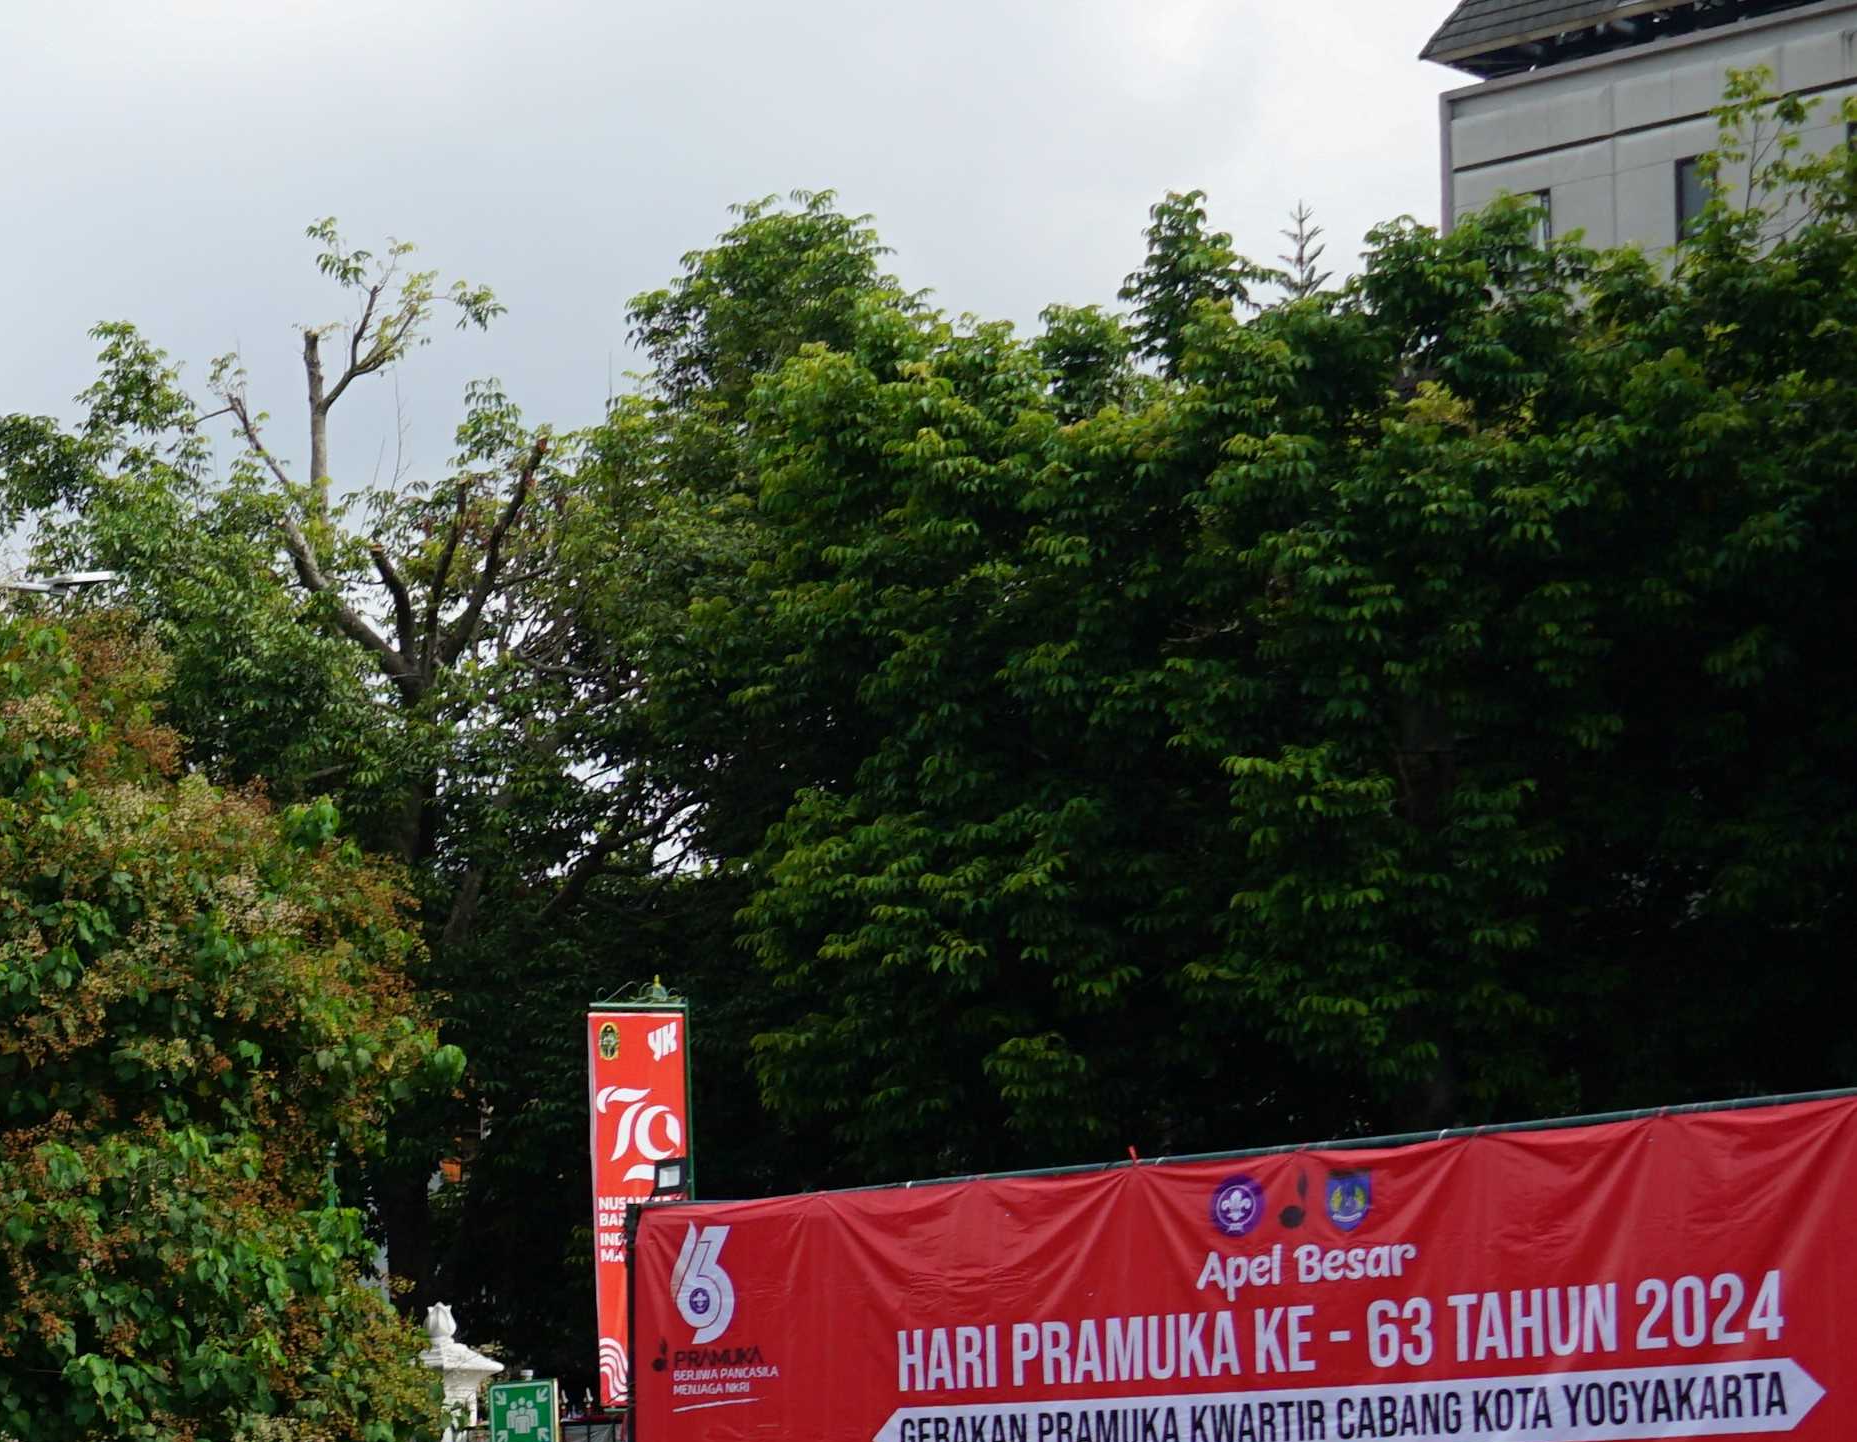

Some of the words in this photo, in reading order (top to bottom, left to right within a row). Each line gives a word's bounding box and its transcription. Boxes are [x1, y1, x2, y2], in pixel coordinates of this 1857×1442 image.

[1195, 1244, 1283, 1302] Apel
[1293, 1242, 1417, 1284] Besar
[673, 1346, 765, 1369] PRAMUKA
[897, 1324, 998, 1392] HARI
[1012, 1309, 1241, 1387] PRAMUKA
[1254, 1304, 1317, 1374] KE
[1328, 1329, 1352, 1344] -
[1366, 1297, 1433, 1368] 63
[1447, 1281, 1618, 1362] TAHUN
[1635, 1268, 1785, 1351] 2024
[720, 1365, 780, 1379] PANCASILA
[1337, 1393, 1461, 1440] CABANG
[1472, 1386, 1553, 1432] KOTA
[1562, 1371, 1788, 1428] YOGYAKARTA
